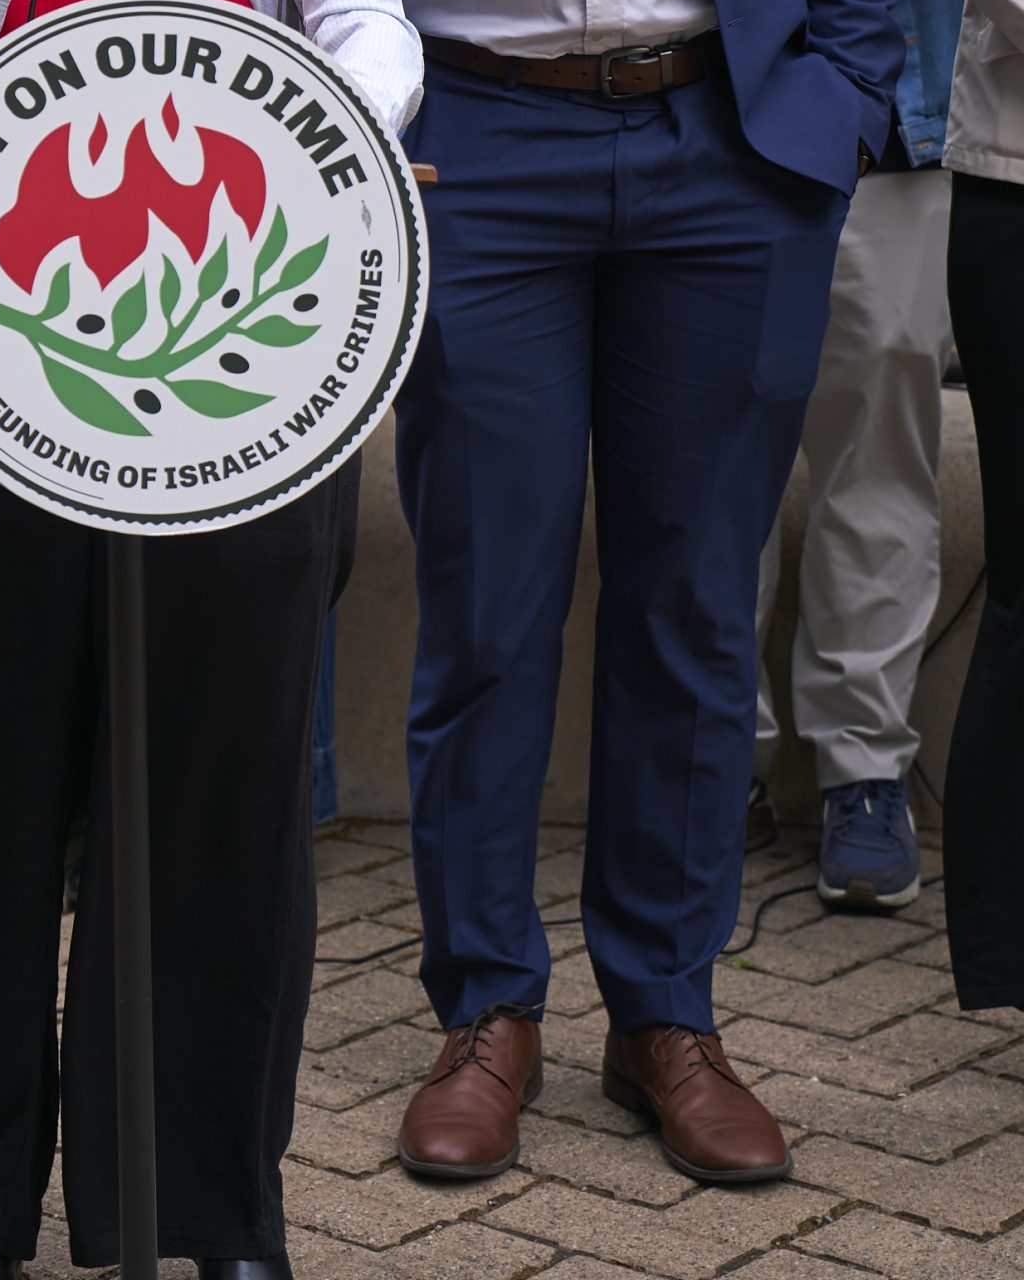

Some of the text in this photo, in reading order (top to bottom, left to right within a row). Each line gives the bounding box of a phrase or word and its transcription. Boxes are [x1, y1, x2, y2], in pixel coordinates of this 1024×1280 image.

[4, 49, 87, 120] ON
[95, 33, 222, 84] OUR
[229, 54, 368, 198] DIME
[117, 465, 157, 490] OF
[164, 428, 290, 490] ISRAELI
[283, 374, 348, 437] WAR
[336, 249, 383, 374] CRIMES
